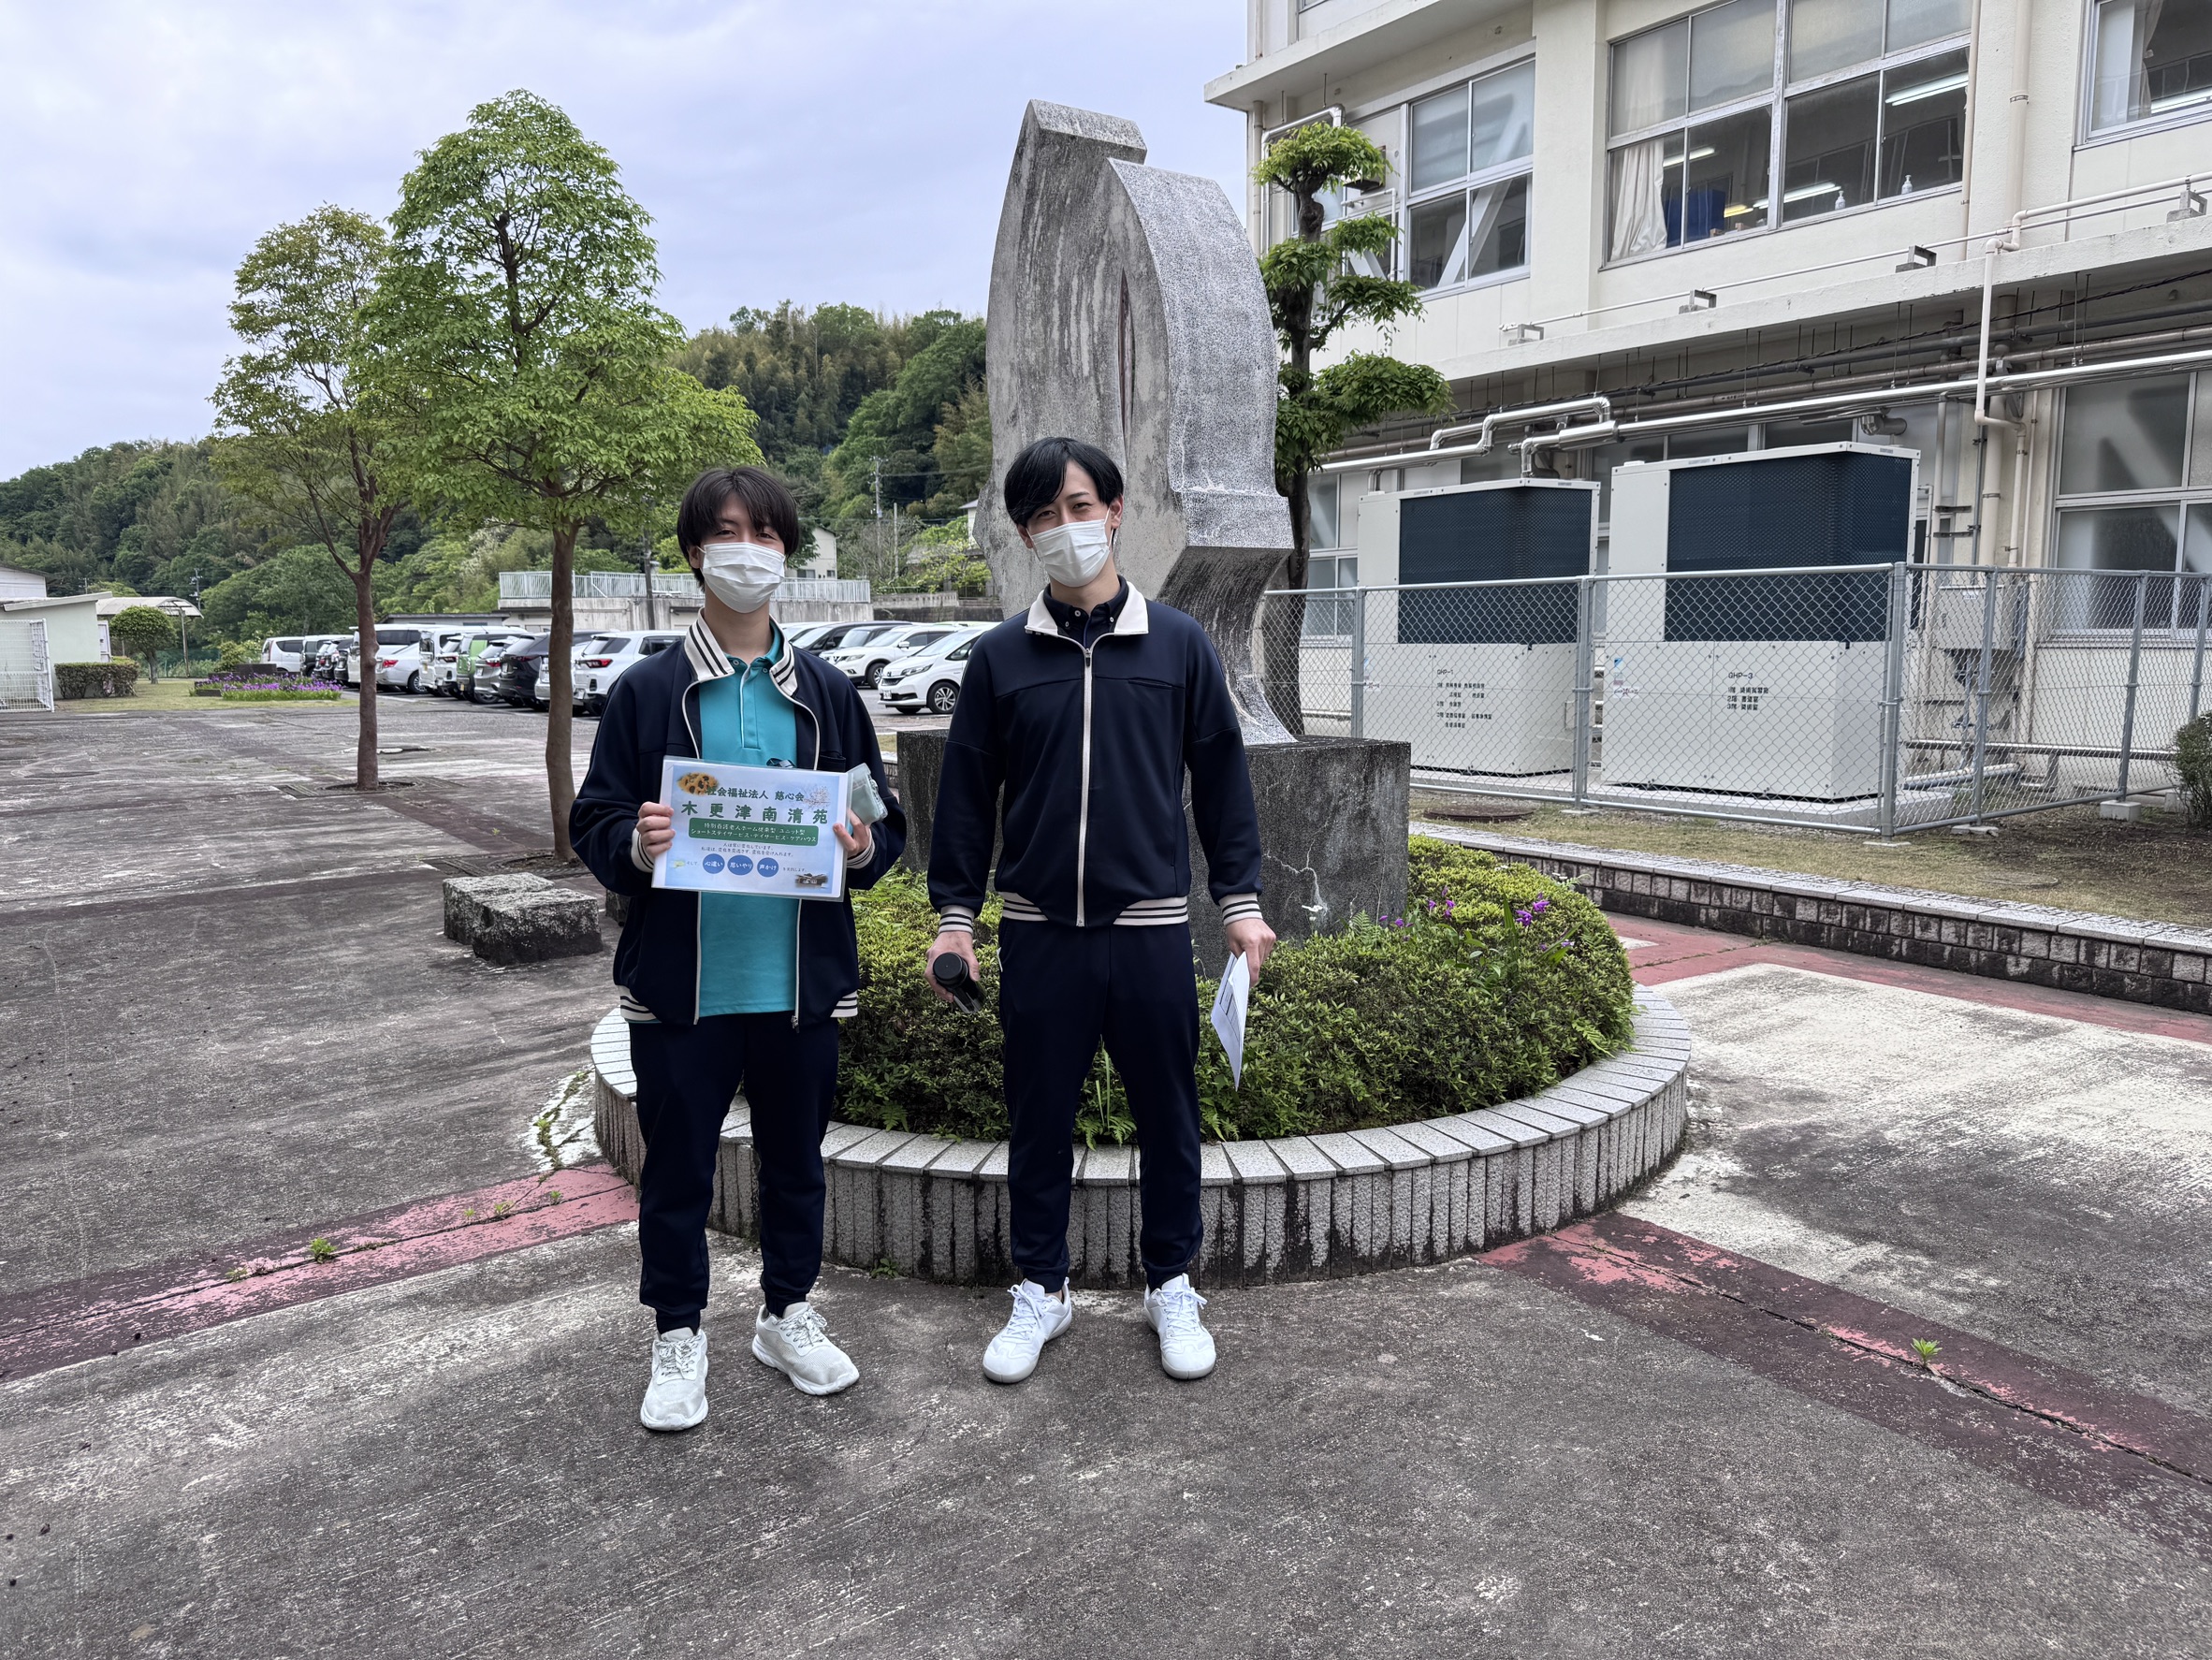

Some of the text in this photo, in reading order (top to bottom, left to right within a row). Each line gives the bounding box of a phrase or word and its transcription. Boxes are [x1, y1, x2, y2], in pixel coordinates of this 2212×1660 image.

[706, 786, 805, 802] 社会福祉法人 慈心会
